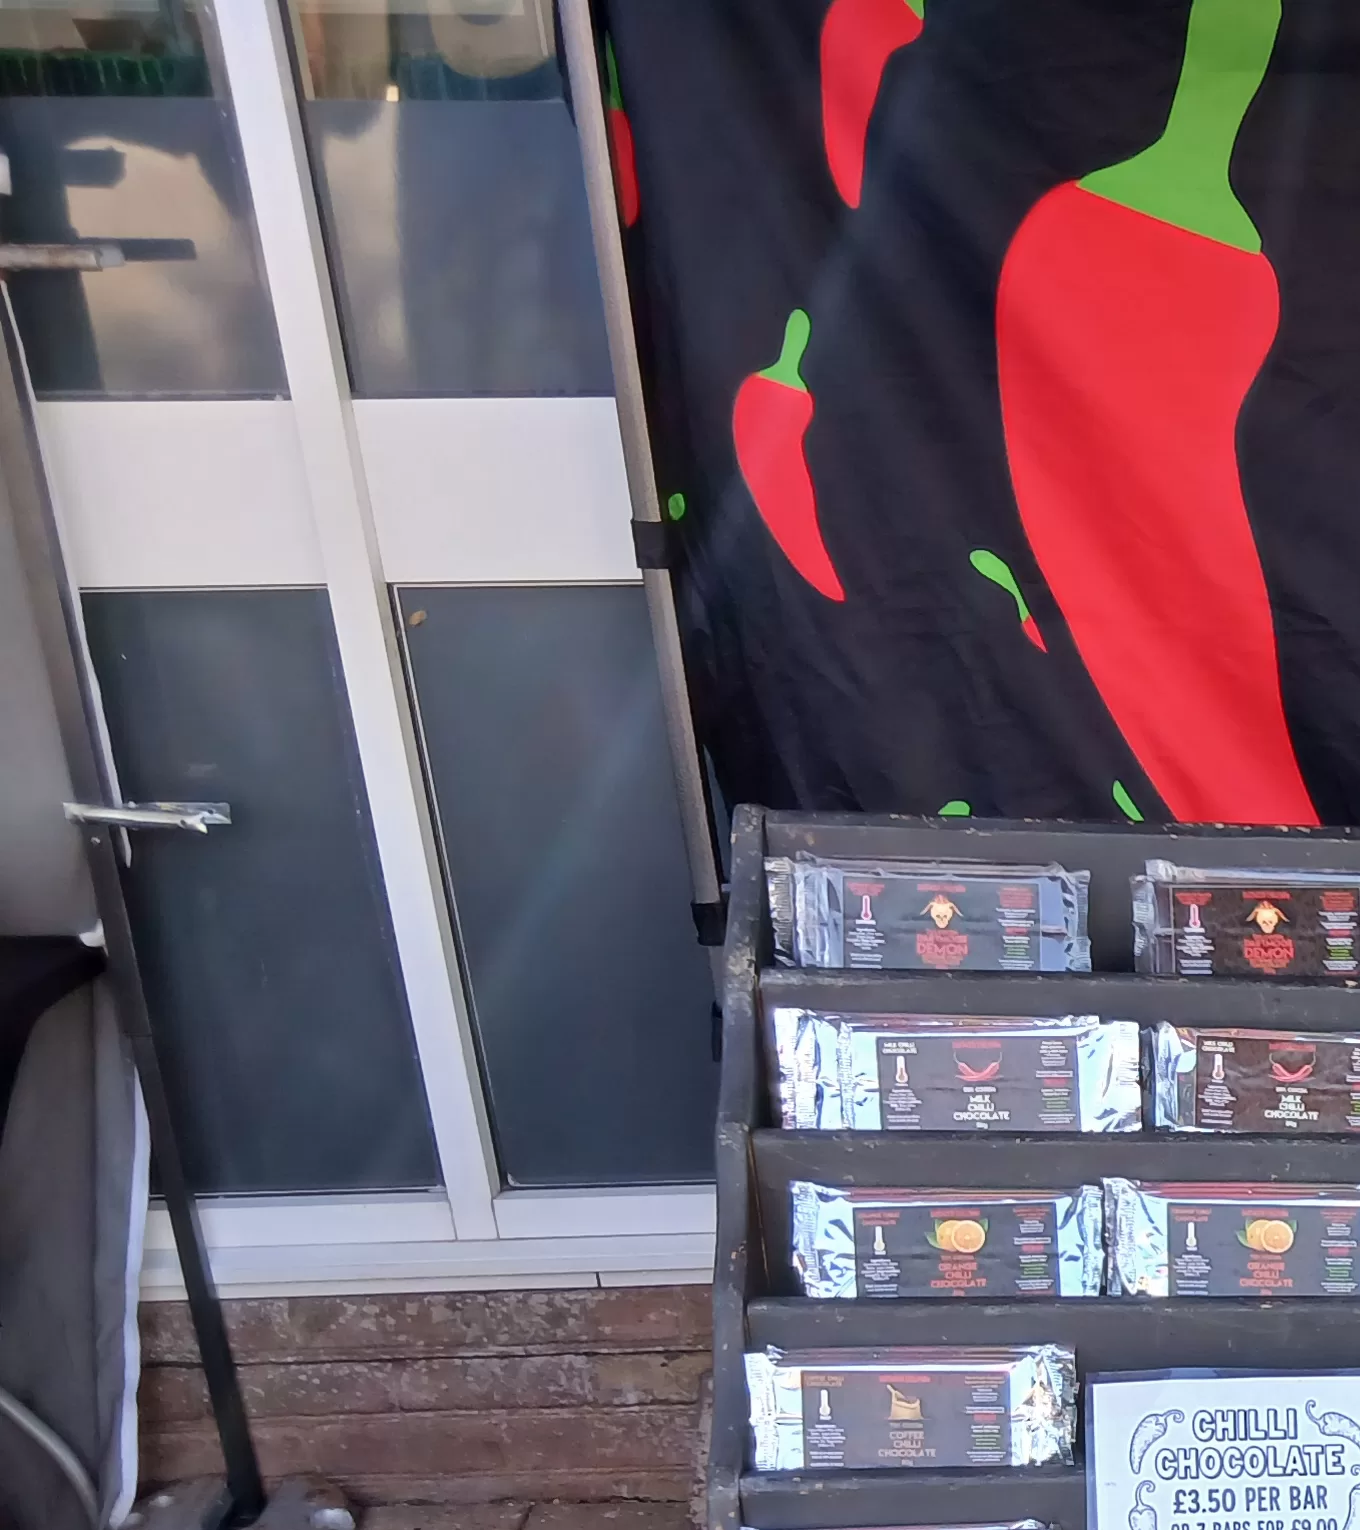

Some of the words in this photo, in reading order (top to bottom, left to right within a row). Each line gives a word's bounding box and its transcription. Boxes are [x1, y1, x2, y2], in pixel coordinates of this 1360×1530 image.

[917, 943, 967, 955] DEMON
[1244, 948, 1294, 958] DEMON
[1281, 1095, 1301, 1103] MILK
[1279, 1103, 1305, 1111] CHILLI
[953, 1111, 1010, 1121] CHOCOLATE
[1264, 1110, 1319, 1121] CHOCOLATE
[939, 1263, 977, 1271] ORANGE
[1247, 1262, 1285, 1270] ORANGE
[931, 1279, 986, 1288] CHOCOLATE
[1240, 1278, 1293, 1288] CHOCOLATE
[1192, 1409, 1297, 1442] CHILLI
[889, 1431, 924, 1440] COFFEE
[894, 1440, 920, 1449] CHILLI
[878, 1449, 936, 1457] CHOCOLATE
[1155, 1444, 1345, 1480] CHOCOLATE
[1173, 1489, 1235, 1515] £3.50
[1245, 1487, 1280, 1512] PER
[1290, 1486, 1328, 1510] BAR
